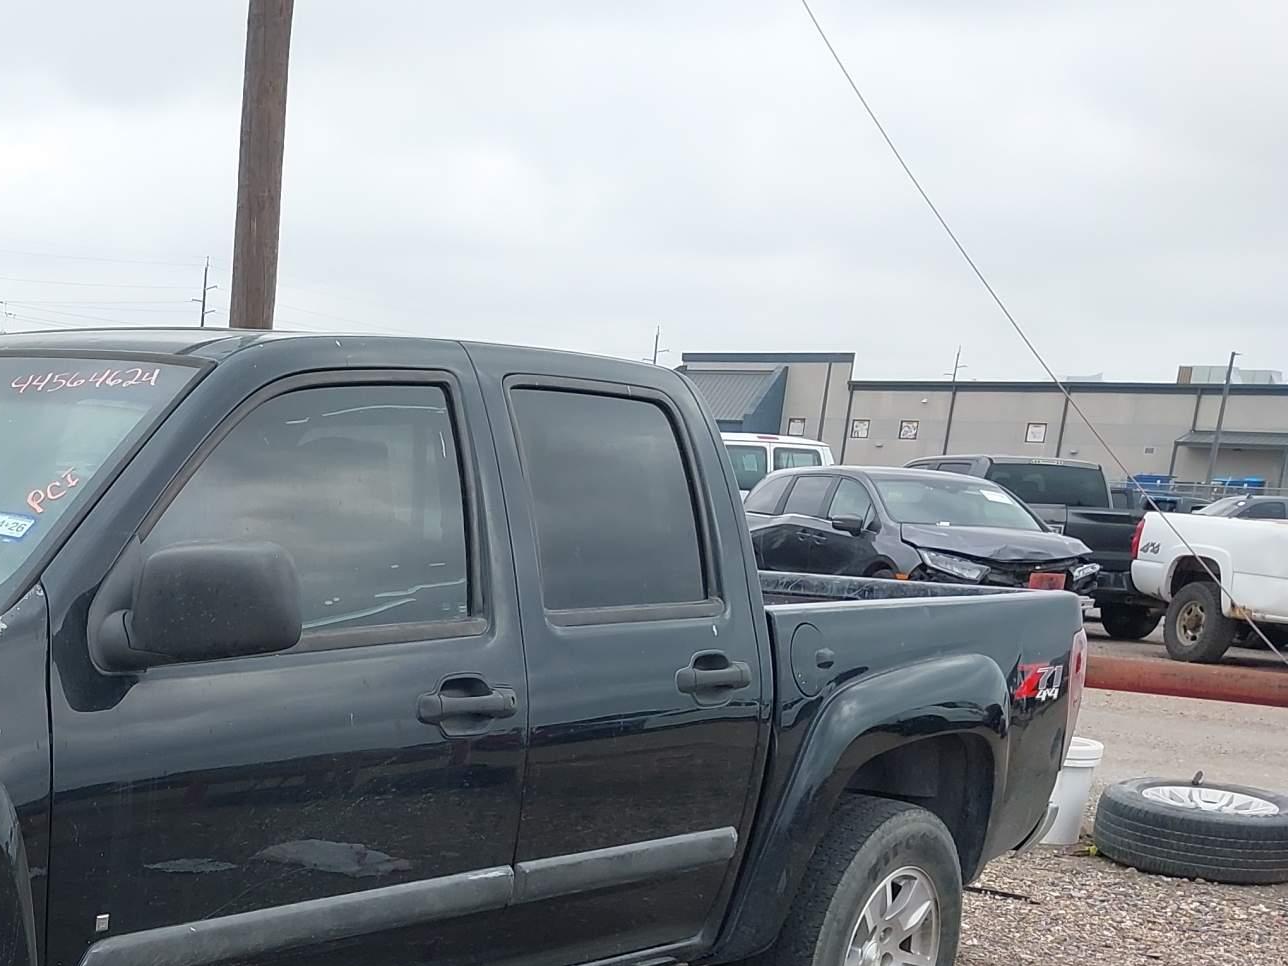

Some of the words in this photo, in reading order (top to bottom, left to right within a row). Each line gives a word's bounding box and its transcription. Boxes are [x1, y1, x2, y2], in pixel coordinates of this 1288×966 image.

[10, 367, 161, 394] 44564624
[26, 466, 81, 514] PCI
[1015, 663, 1064, 700] Z71
